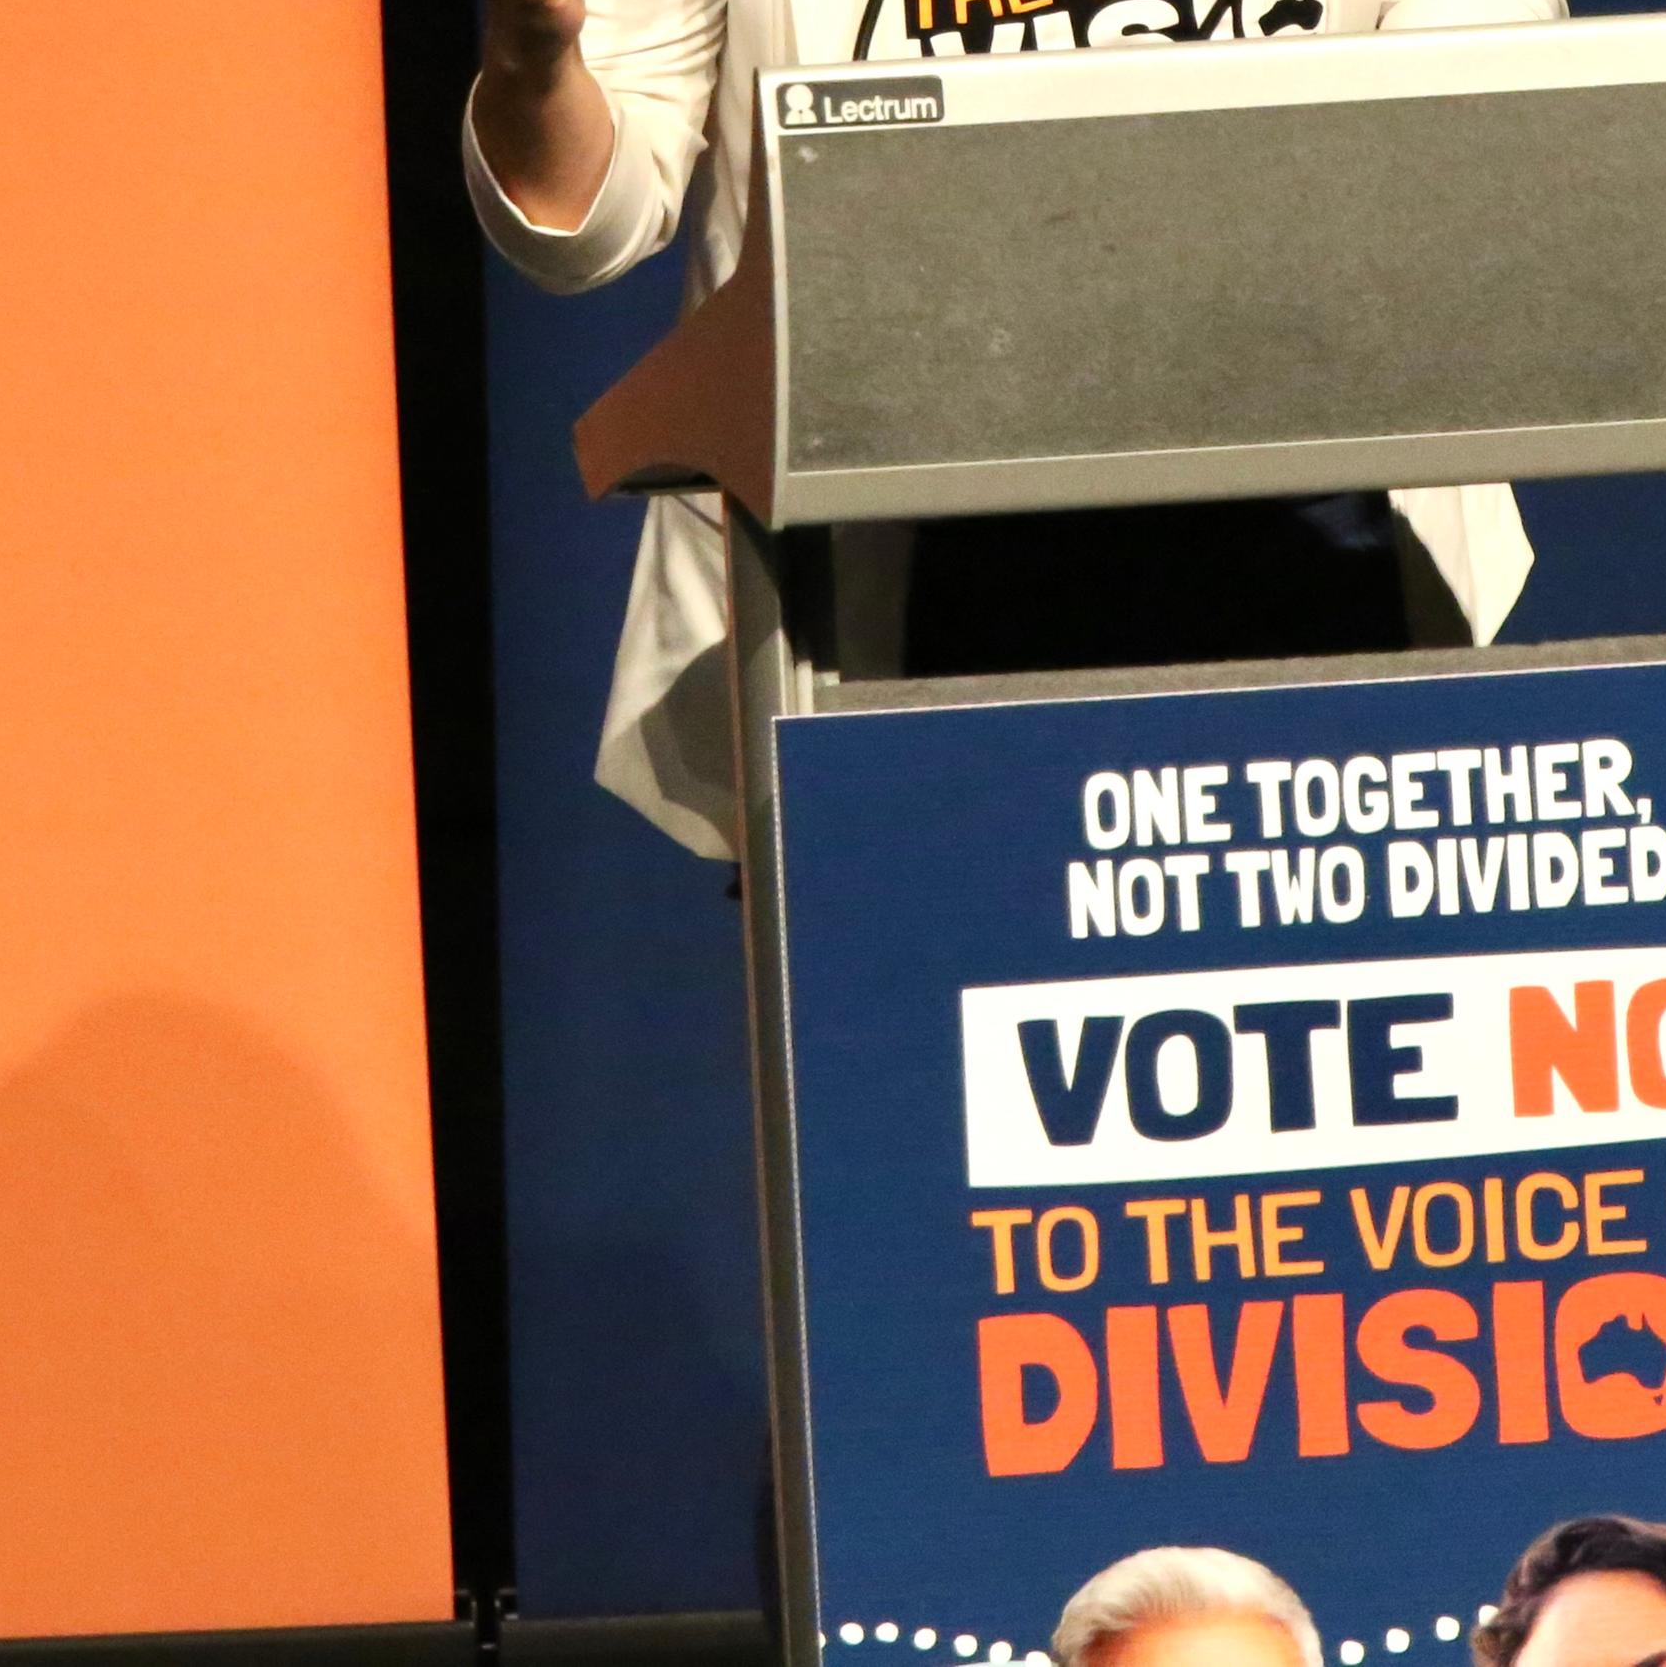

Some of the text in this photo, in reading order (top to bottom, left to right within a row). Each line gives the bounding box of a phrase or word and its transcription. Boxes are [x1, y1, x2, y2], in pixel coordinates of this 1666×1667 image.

[825, 95, 938, 124] Lectrum
[1083, 738, 1652, 850] ONE TOGETHER,
[1068, 854, 1210, 939] NOT
[1225, 844, 1365, 928] TWO
[1016, 992, 1459, 1146] VOTE
[971, 1205, 1100, 1295] TO
[1126, 1189, 1325, 1284] THE
[1351, 1168, 1648, 1272] VOICE
